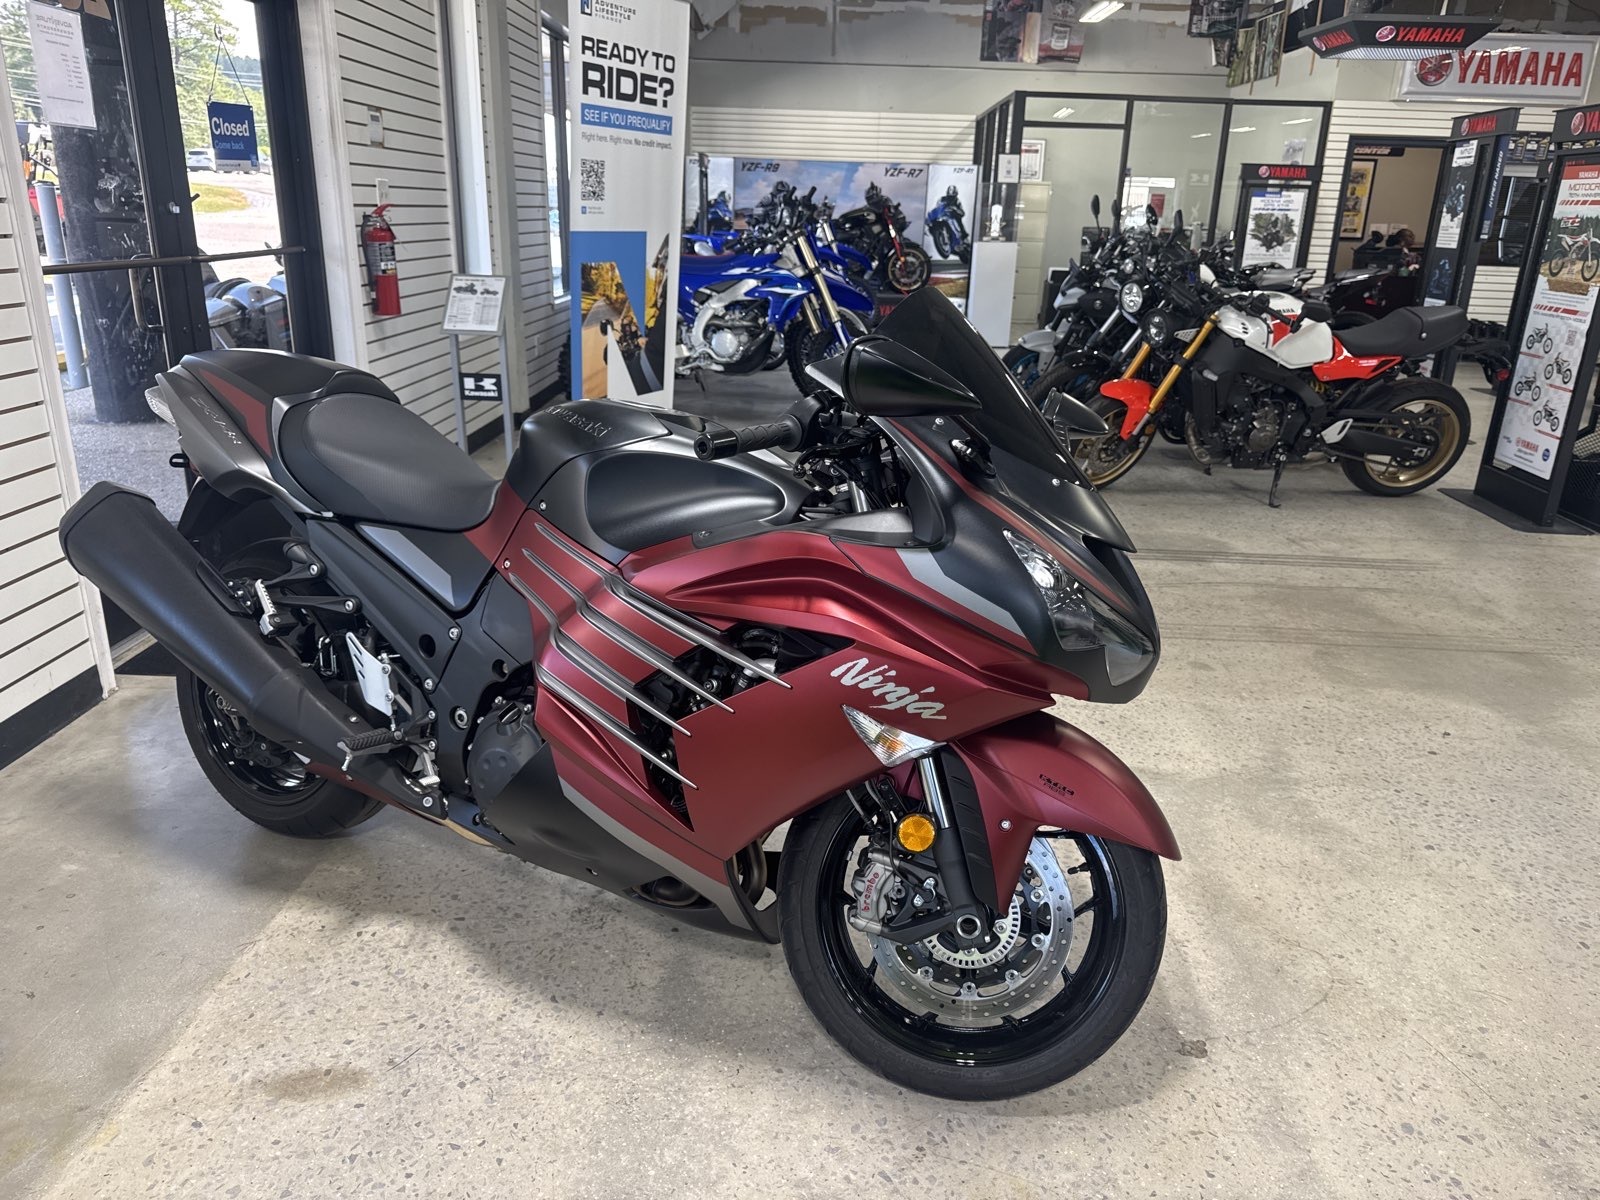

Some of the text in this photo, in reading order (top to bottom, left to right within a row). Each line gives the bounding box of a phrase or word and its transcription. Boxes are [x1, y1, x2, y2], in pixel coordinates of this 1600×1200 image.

[595, 0, 637, 15] ADVENTURE
[595, 6, 632, 20] LIFESTYLE
[1322, 28, 1354, 49] YAMAHA
[1396, 26, 1467, 43] YAMAHA
[581, 35, 675, 74] READY TO
[1456, 50, 1584, 87] YAMAHA
[582, 61, 675, 109] RIDE?
[211, 116, 250, 137] Closed
[584, 108, 672, 132] SEE IF YOU PREQUALIFY
[1470, 115, 1498, 134] YAMAHA
[214, 140, 245, 150] Come back
[581, 132, 596, 143] Right
[609, 135, 623, 146] Right
[741, 162, 781, 173] YZF-R9
[883, 167, 924, 179] YZF-R7
[1270, 166, 1308, 179] YAMAHA
[1488, 150, 1504, 208] HYPER NAKED
[464, 389, 498, 398] Kawasaki
[830, 657, 947, 720] Ninja
[862, 872, 880, 912] brembo
